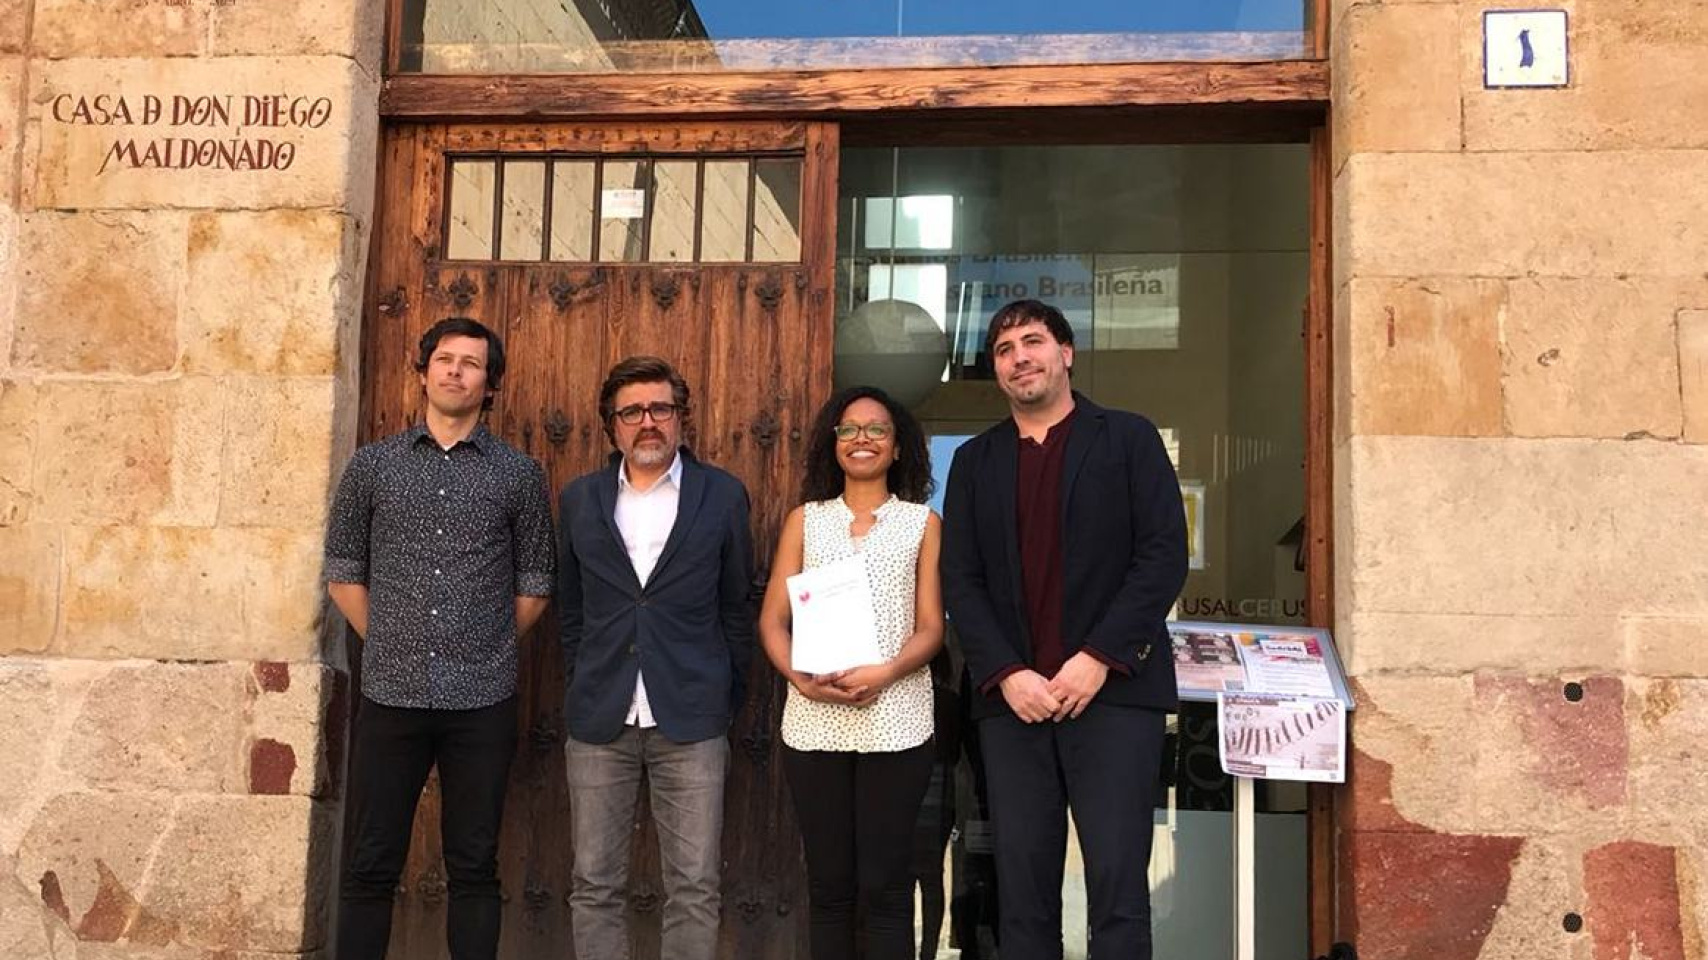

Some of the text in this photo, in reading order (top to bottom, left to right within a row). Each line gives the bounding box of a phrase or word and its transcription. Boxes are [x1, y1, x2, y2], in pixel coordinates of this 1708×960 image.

[52, 93, 134, 126] CASA
[169, 94, 233, 127] DON
[95, 138, 296, 177] MALDONADO
[1038, 273, 1165, 297] Brasileña
